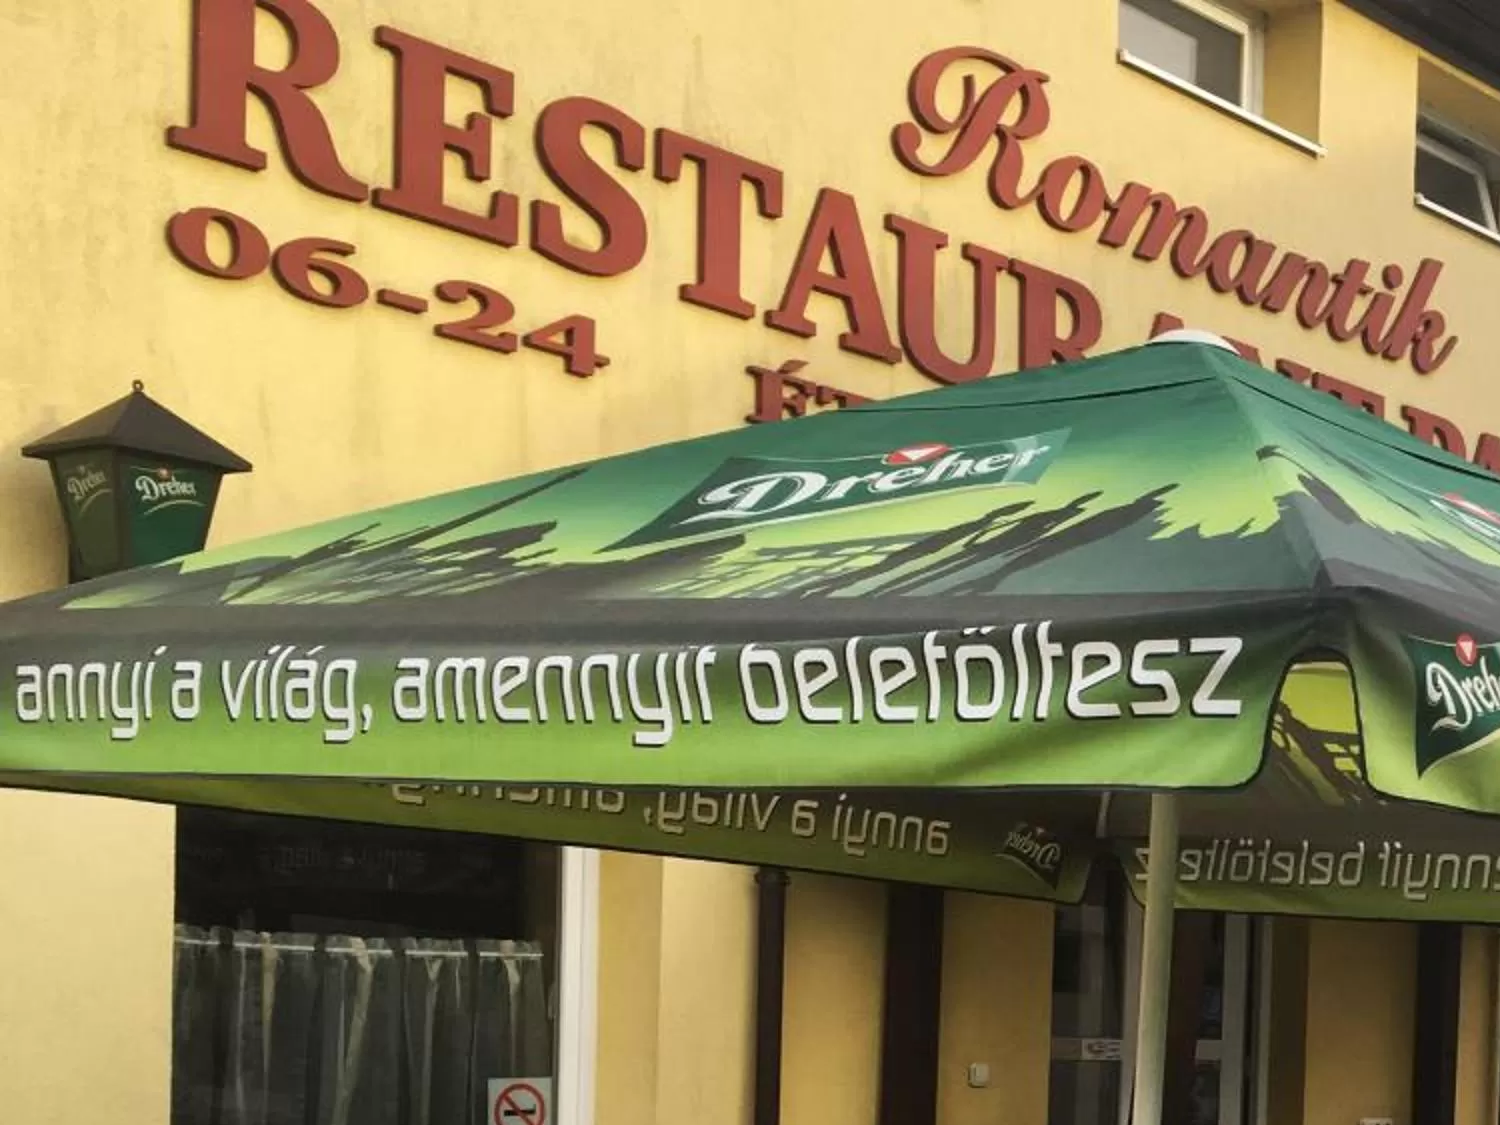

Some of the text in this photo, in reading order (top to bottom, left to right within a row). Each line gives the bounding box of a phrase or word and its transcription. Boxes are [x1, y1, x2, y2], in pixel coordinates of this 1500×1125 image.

[166, 0, 1385, 420] RESTAUR
[892, 44, 1458, 376] Romantik
[166, 207, 611, 377] 06-24
[135, 475, 197, 501] Dreher
[670, 445, 1050, 528] Dreher
[171, 659, 202, 720] a
[394, 645, 717, 747] amennyit
